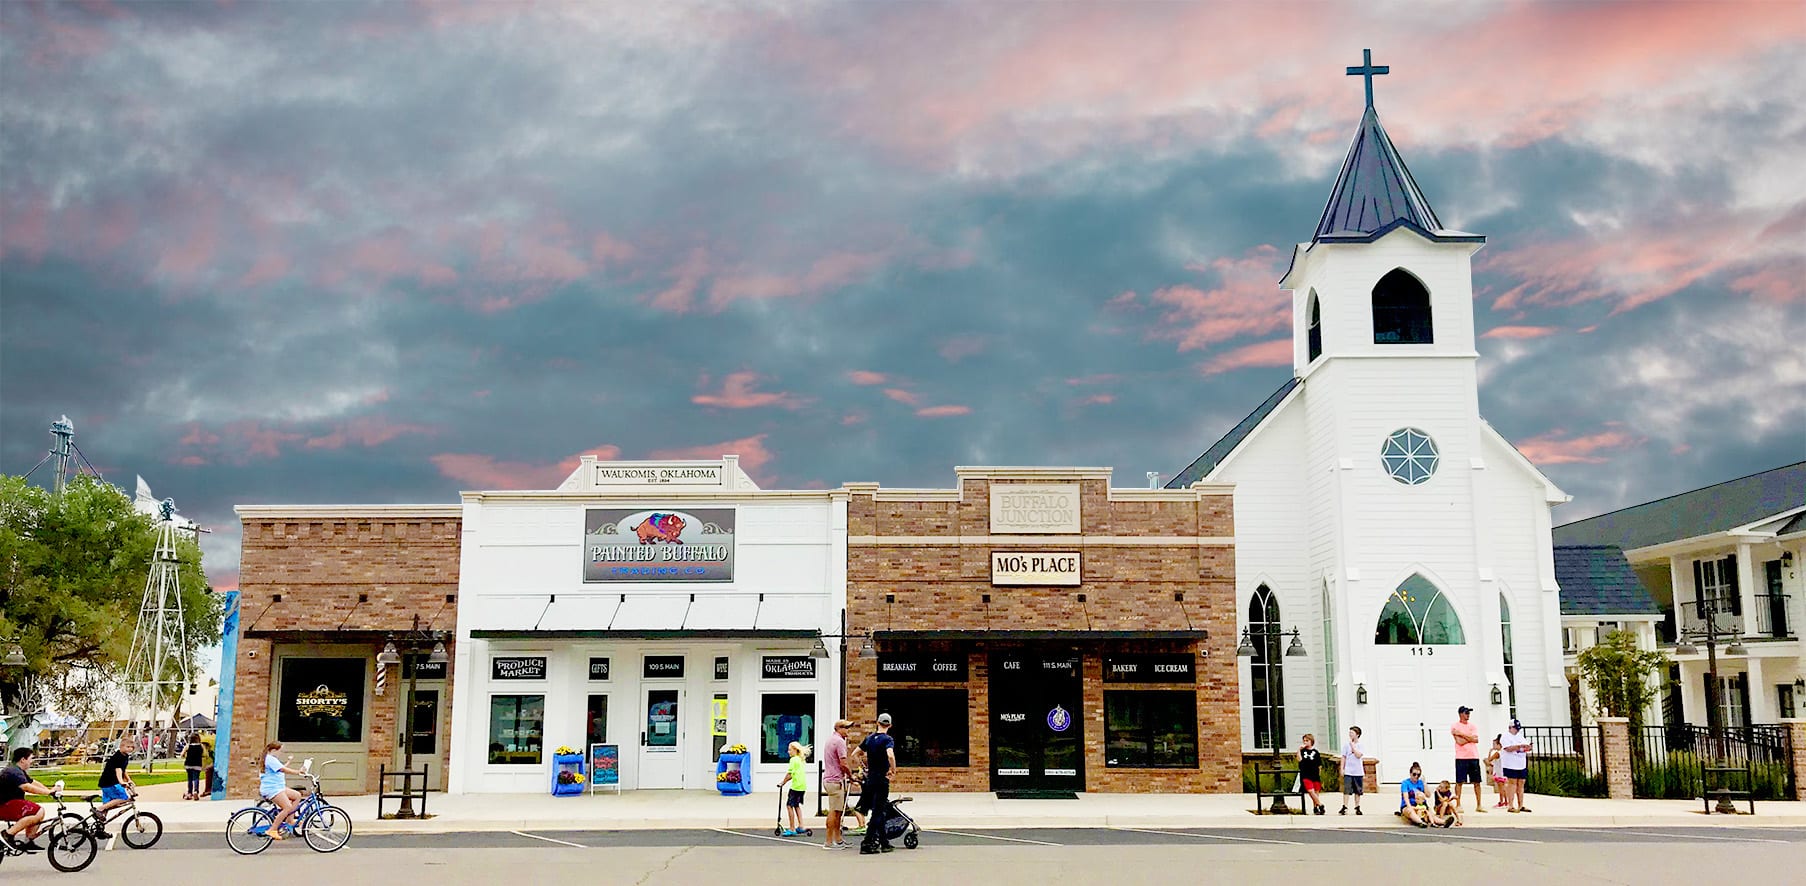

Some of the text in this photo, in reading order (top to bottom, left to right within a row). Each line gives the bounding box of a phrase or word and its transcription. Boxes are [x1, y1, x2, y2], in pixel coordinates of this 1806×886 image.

[601, 470, 716, 480] WAUKOMIS, OKLAHOMA
[1001, 495, 1070, 509] BUFFALO
[997, 509, 1074, 523] JUNCTION
[591, 545, 729, 562] PAINTED BUFFALO
[1031, 557, 1076, 573] PLACE
[611, 567, 679, 575] TRADING
[496, 658, 544, 670] PRODUCE
[591, 663, 607, 673] GIFTS
[648, 663, 659, 671] 109
[765, 661, 813, 673] OKLAHOMA
[882, 663, 917, 672] BREAKFAST
[932, 663, 958, 672] COFFEE
[1003, 661, 1021, 670] CAFE
[1112, 664, 1138, 673] BAKERY
[1154, 664, 1188, 673] ICE CREAM
[500, 667, 541, 677] MARKET
